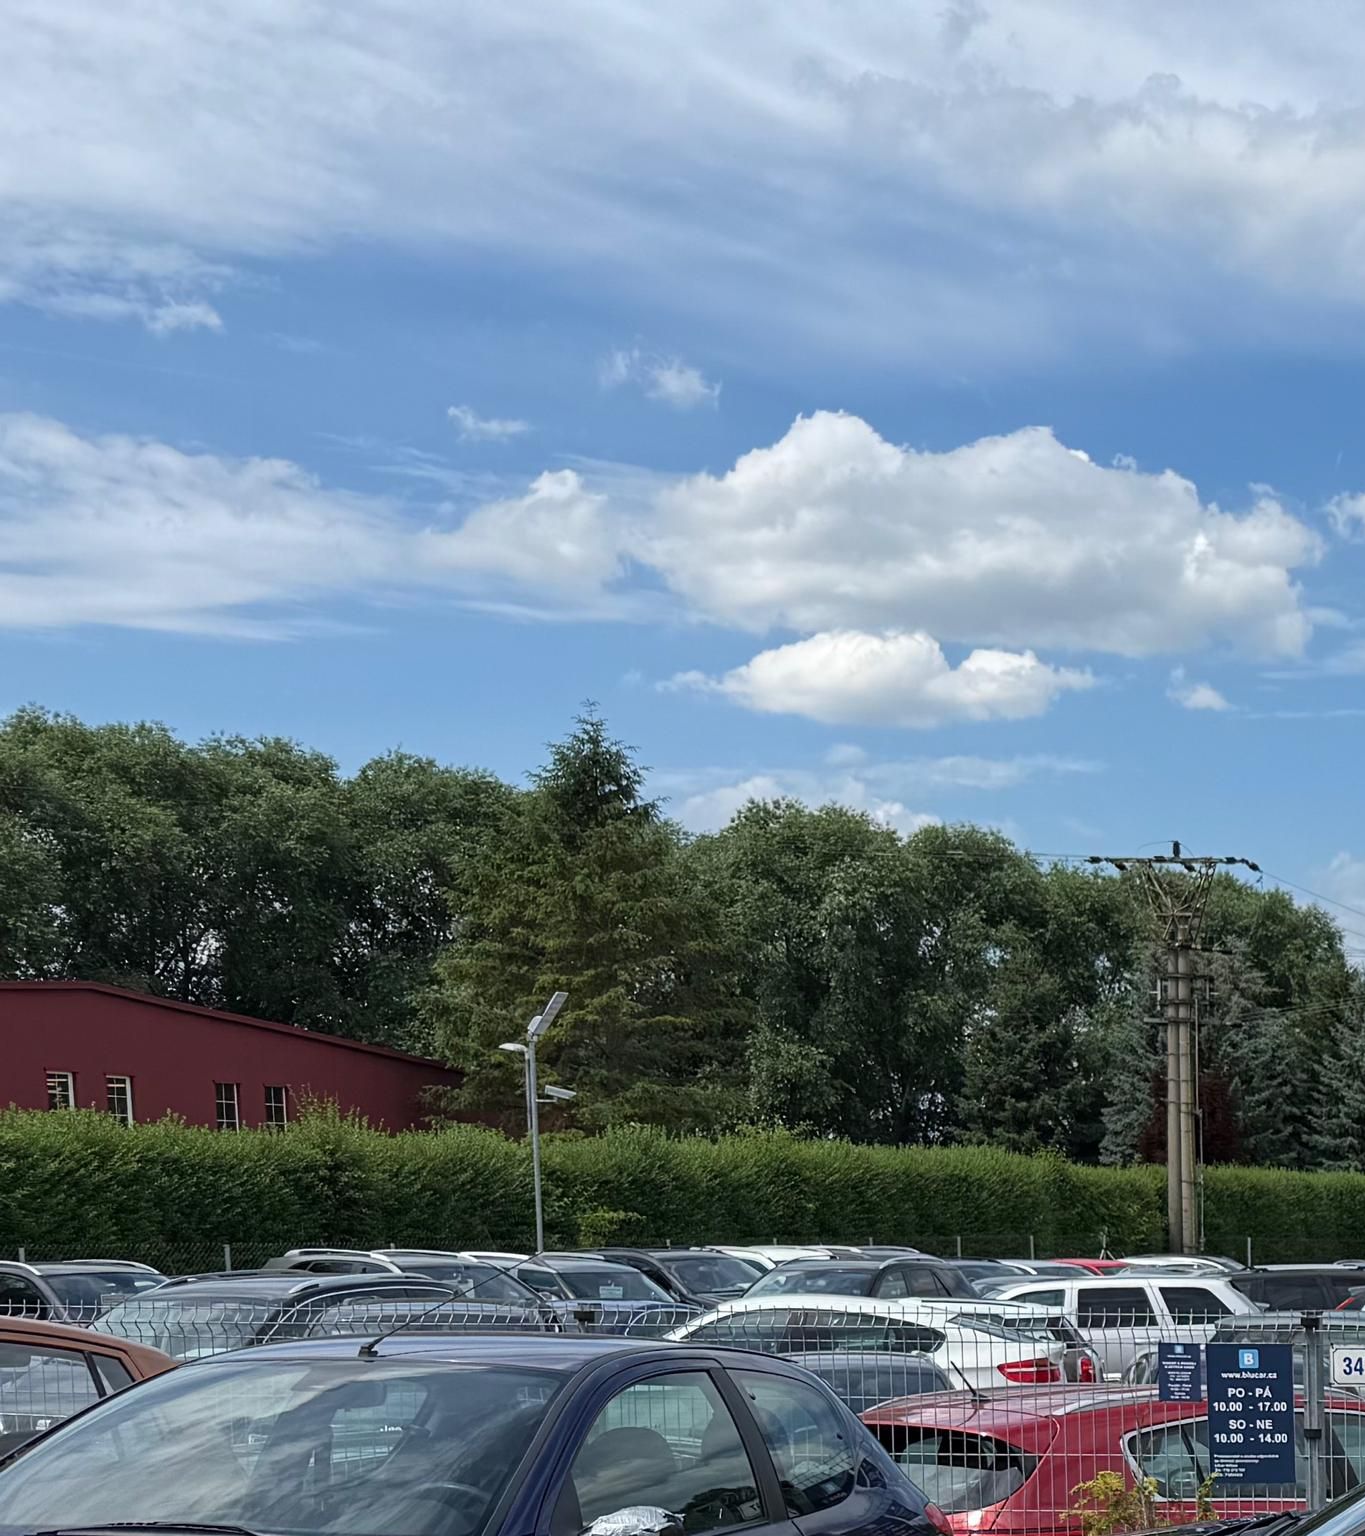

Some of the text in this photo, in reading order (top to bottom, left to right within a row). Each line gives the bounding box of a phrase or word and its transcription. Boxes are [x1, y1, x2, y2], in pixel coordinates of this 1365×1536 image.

[1243, 1352, 1254, 1365] B
[1227, 1387, 1246, 1398] PO
[1255, 1385, 1272, 1398] PÁ
[1213, 1401, 1243, 1412] 10.00
[1257, 1401, 1287, 1412] 17.00
[1228, 1419, 1246, 1430] SO
[1256, 1419, 1273, 1430] NE
[1214, 1433, 1244, 1443] 10.00
[1258, 1433, 1288, 1443] 14.00
